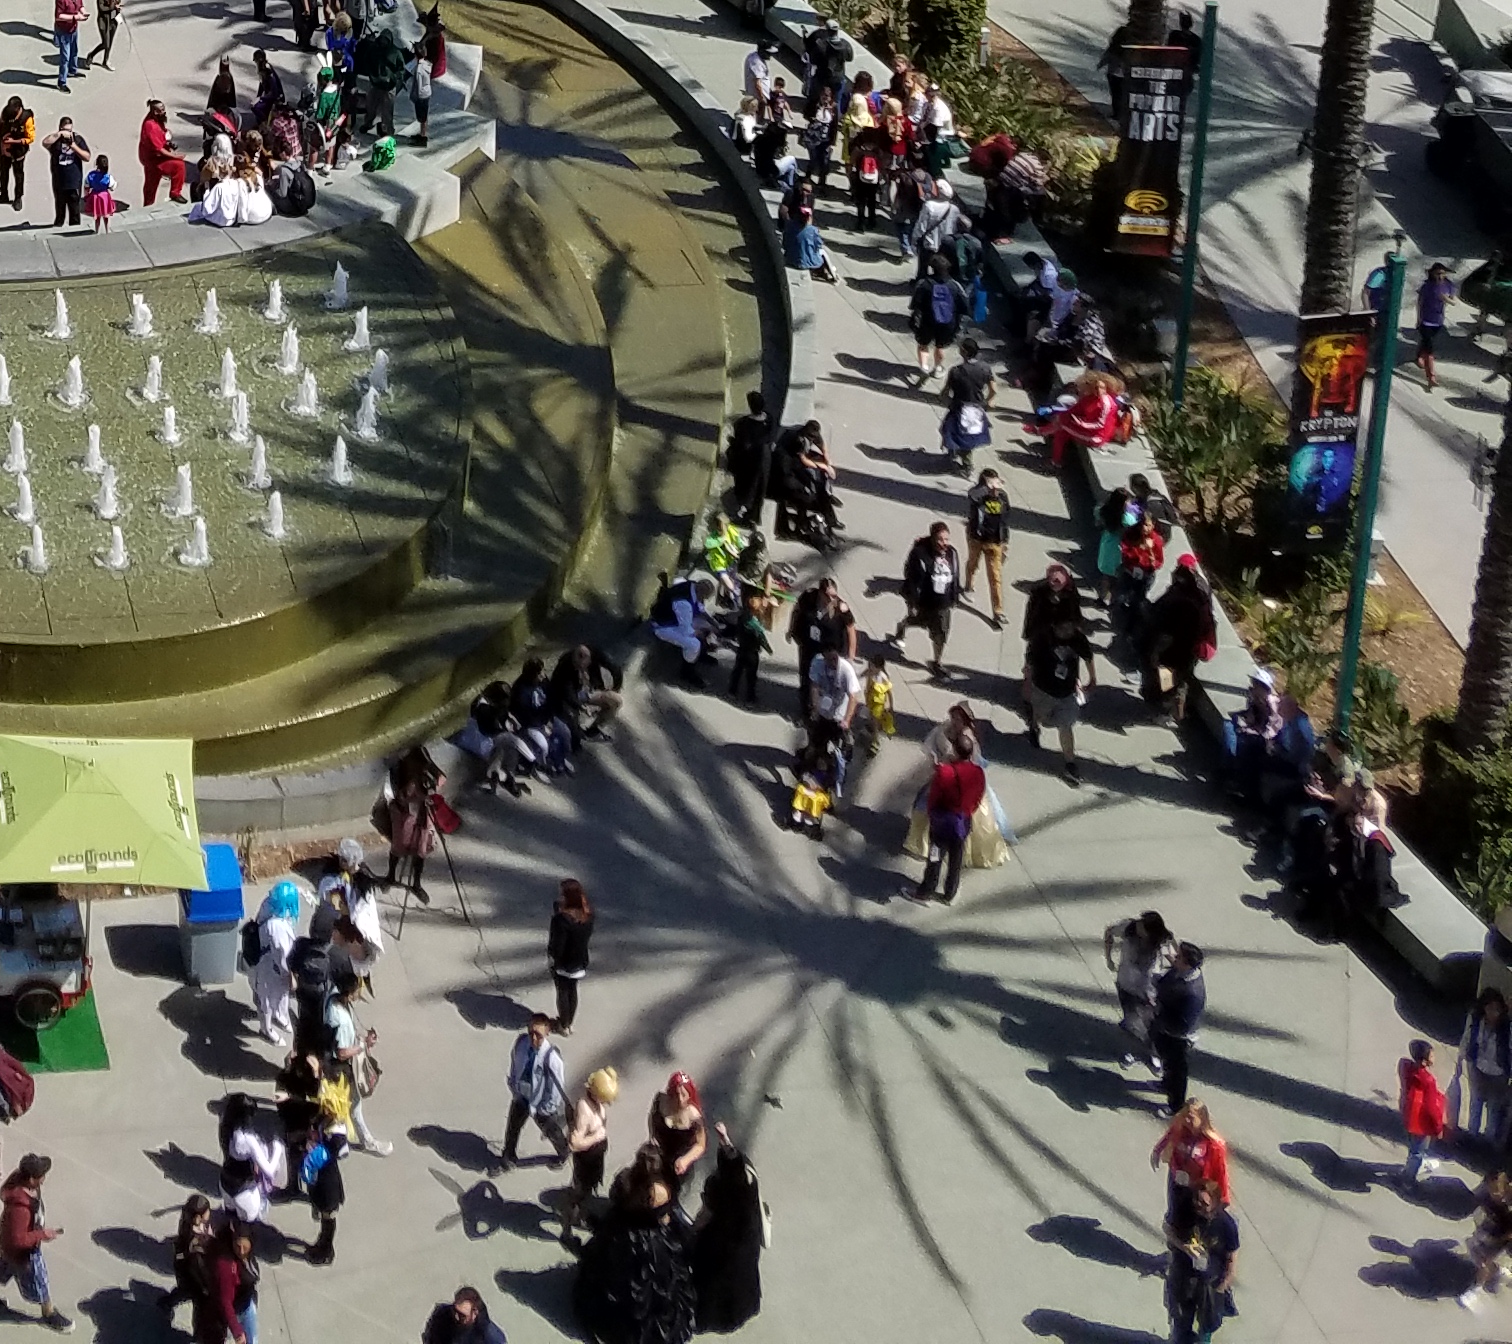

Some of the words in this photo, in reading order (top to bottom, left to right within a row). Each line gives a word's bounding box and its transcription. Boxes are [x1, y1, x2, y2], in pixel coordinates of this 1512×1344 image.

[1128, 111, 1180, 142] ARTS
[1299, 416, 1358, 433] KRYPTON
[58, 845, 138, 874] ecogrounds
